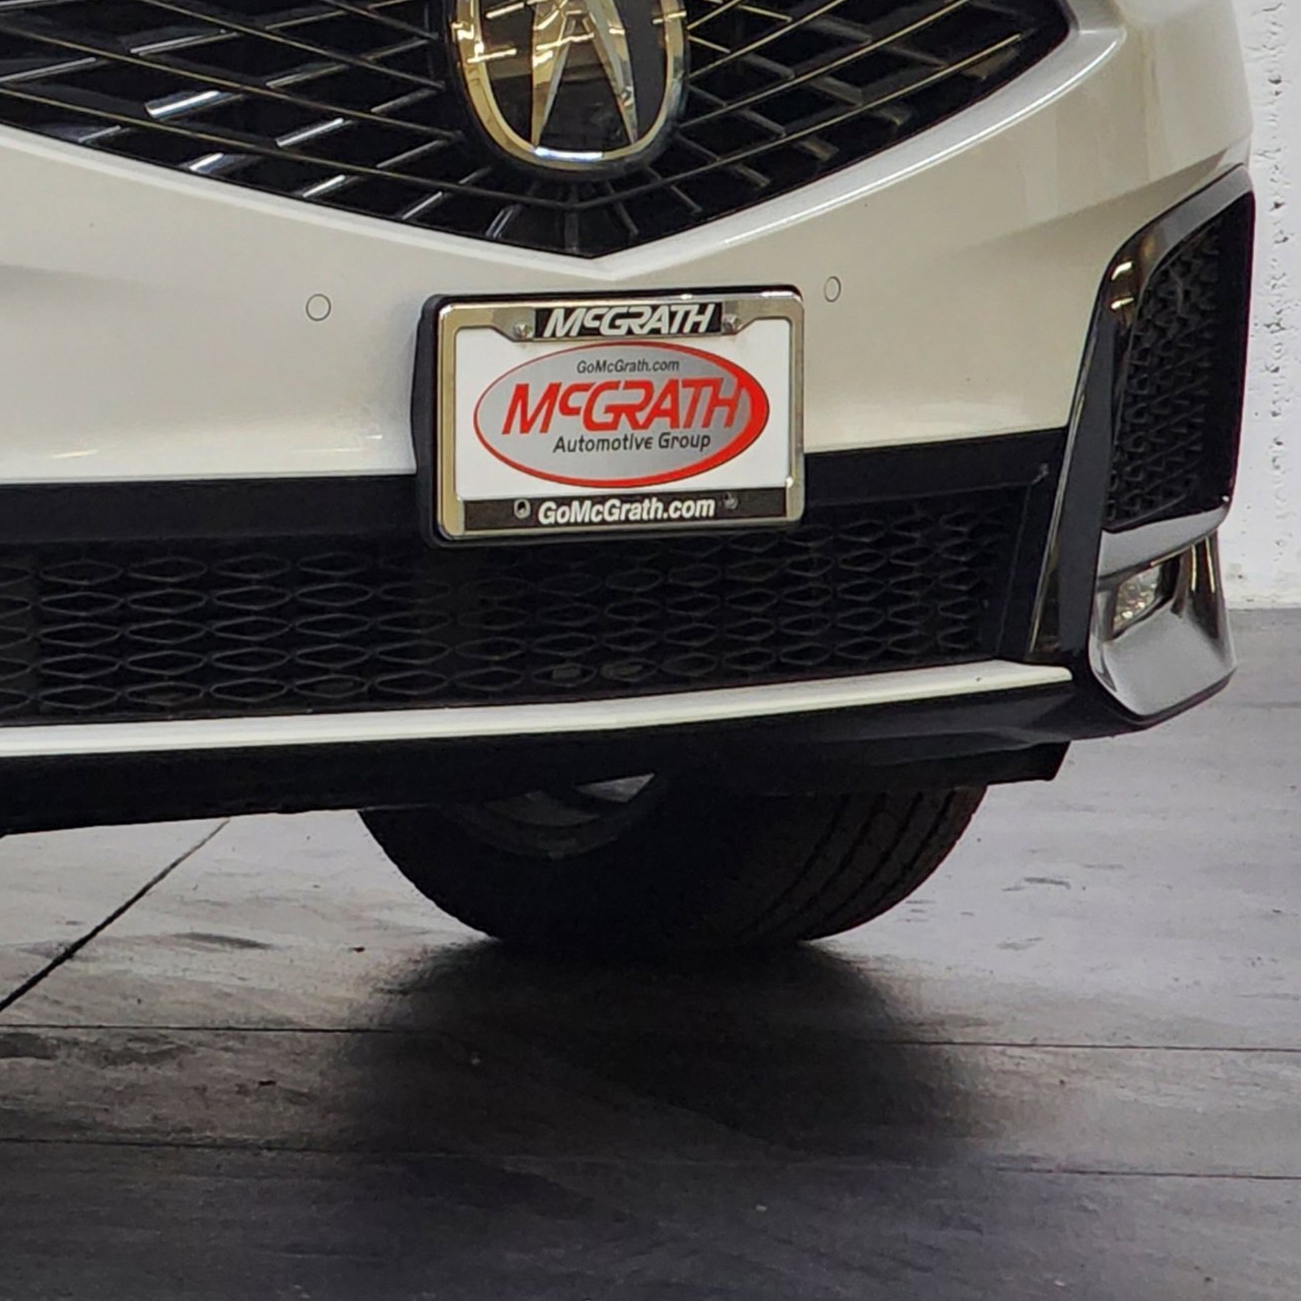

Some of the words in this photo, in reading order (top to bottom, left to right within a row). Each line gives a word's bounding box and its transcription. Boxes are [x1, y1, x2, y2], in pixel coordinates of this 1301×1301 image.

[576, 357, 680, 375] GoMcGrath.com
[553, 433, 653, 454] Automotive
[658, 432, 711, 452] Group
[538, 497, 715, 525] GoMcGrath.com
